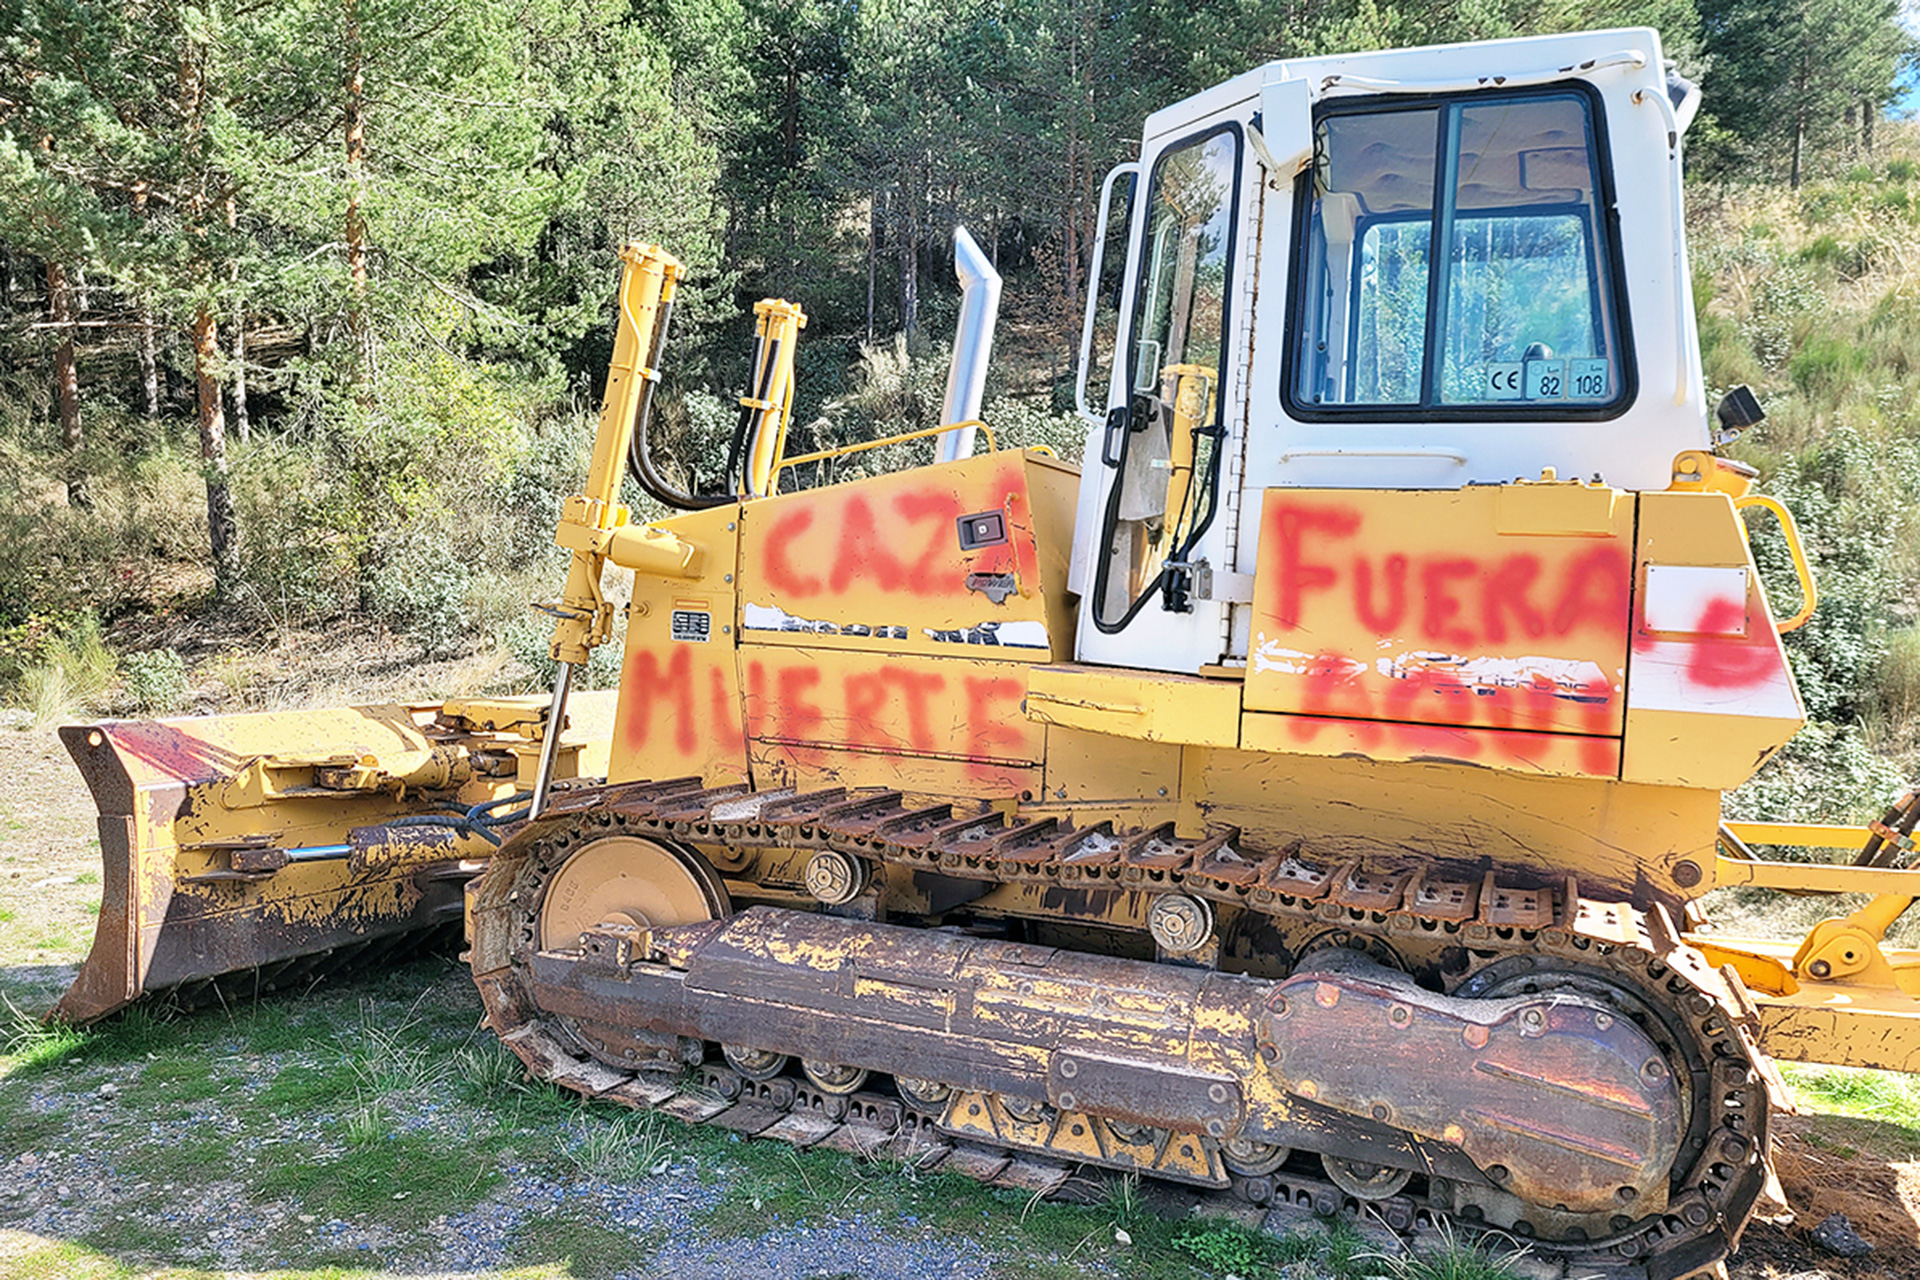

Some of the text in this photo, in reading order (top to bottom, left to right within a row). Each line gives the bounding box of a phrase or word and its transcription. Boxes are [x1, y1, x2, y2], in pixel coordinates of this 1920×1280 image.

[1491, 371, 1518, 390] CE
[1540, 376, 1560, 396] 82
[1576, 375, 1602, 395] 108
[1271, 505, 1654, 652] FUERA
[625, 643, 1028, 792] MUERTE
